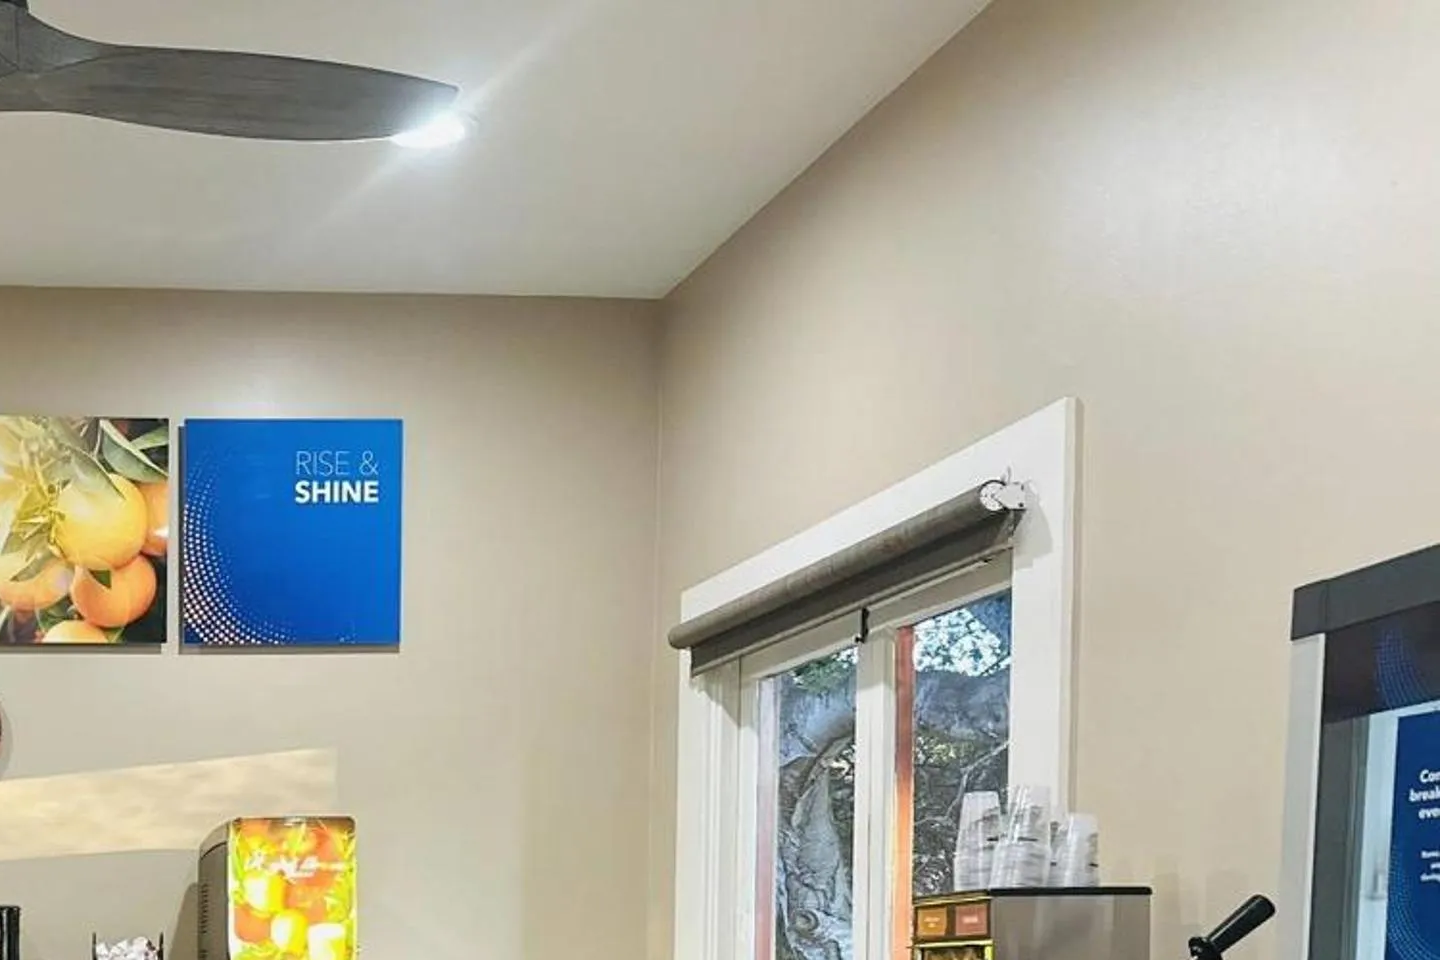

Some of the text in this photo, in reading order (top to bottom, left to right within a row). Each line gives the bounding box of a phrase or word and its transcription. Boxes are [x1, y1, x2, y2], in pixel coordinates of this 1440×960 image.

[295, 449, 380, 476] RISE &
[294, 480, 380, 504] SHINE
